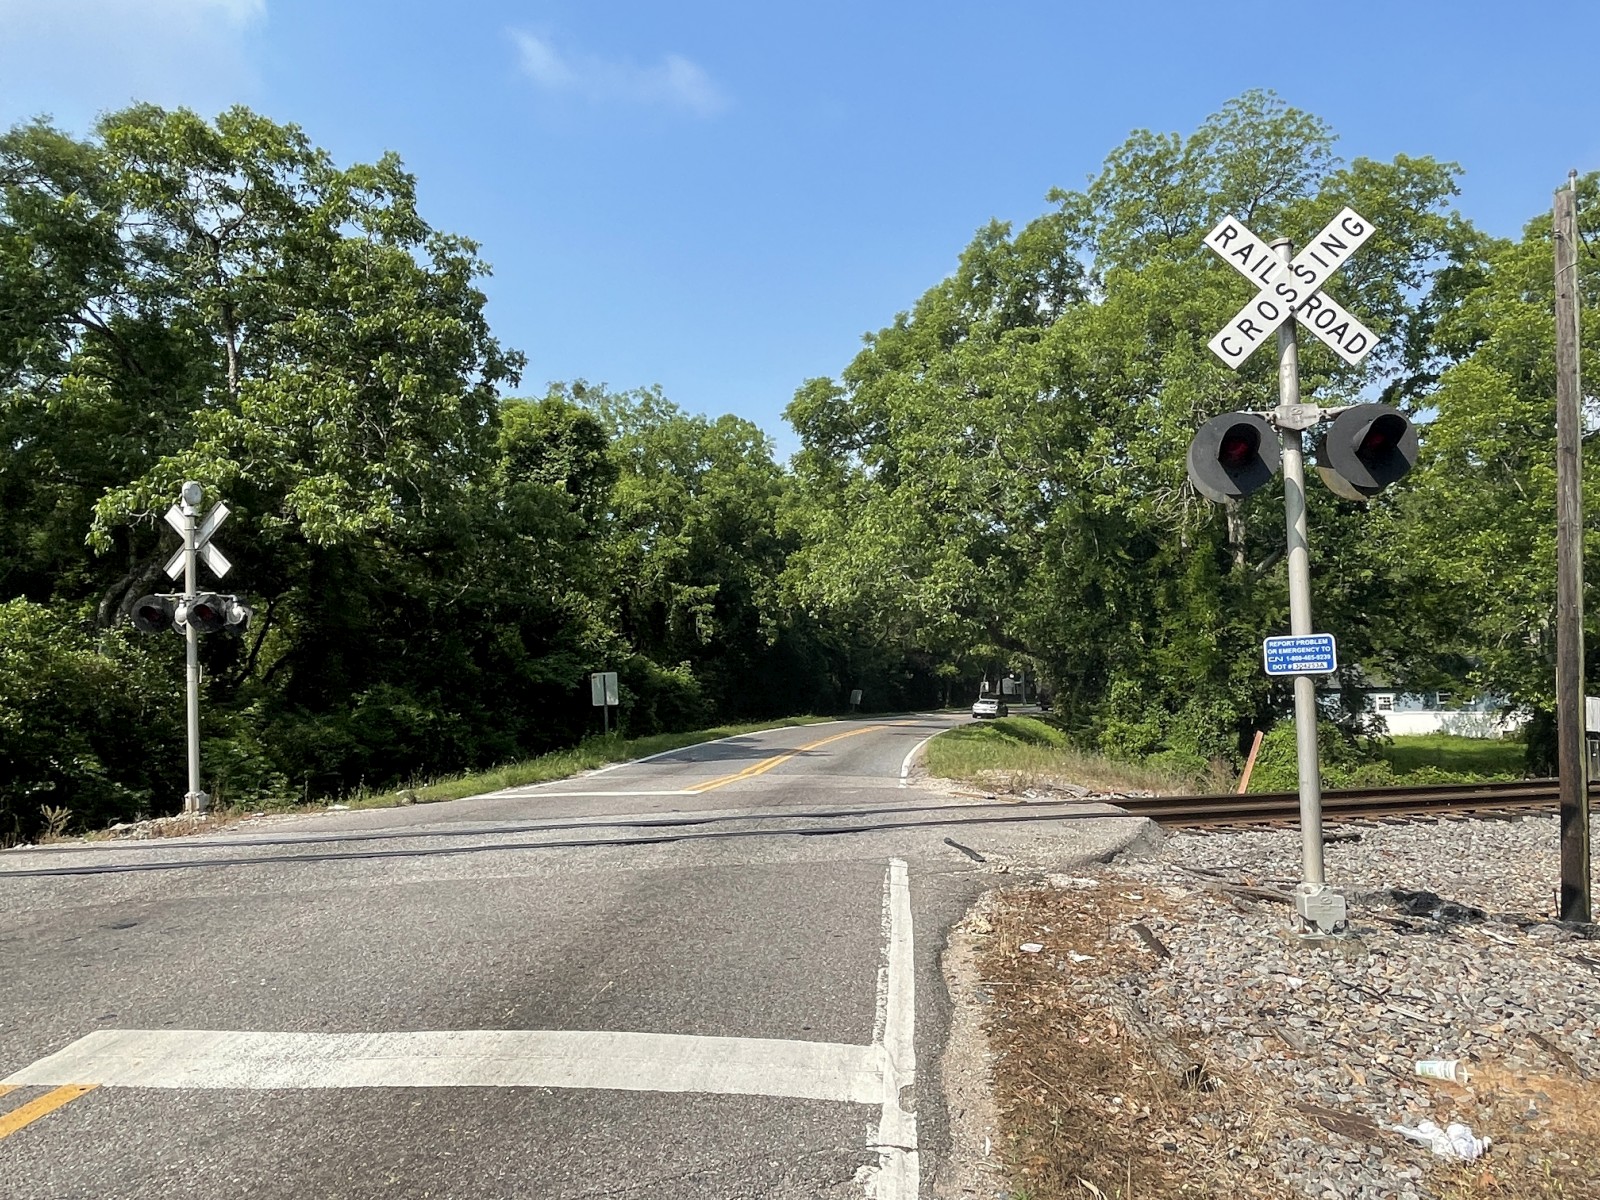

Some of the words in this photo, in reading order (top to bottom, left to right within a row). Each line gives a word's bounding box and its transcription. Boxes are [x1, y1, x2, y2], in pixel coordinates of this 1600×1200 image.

[1214, 224, 1276, 285] RAIL
[1296, 294, 1367, 355] ROAD
[1220, 217, 1364, 357] CROSSING
[1296, 638, 1328, 646] PROBLEM
